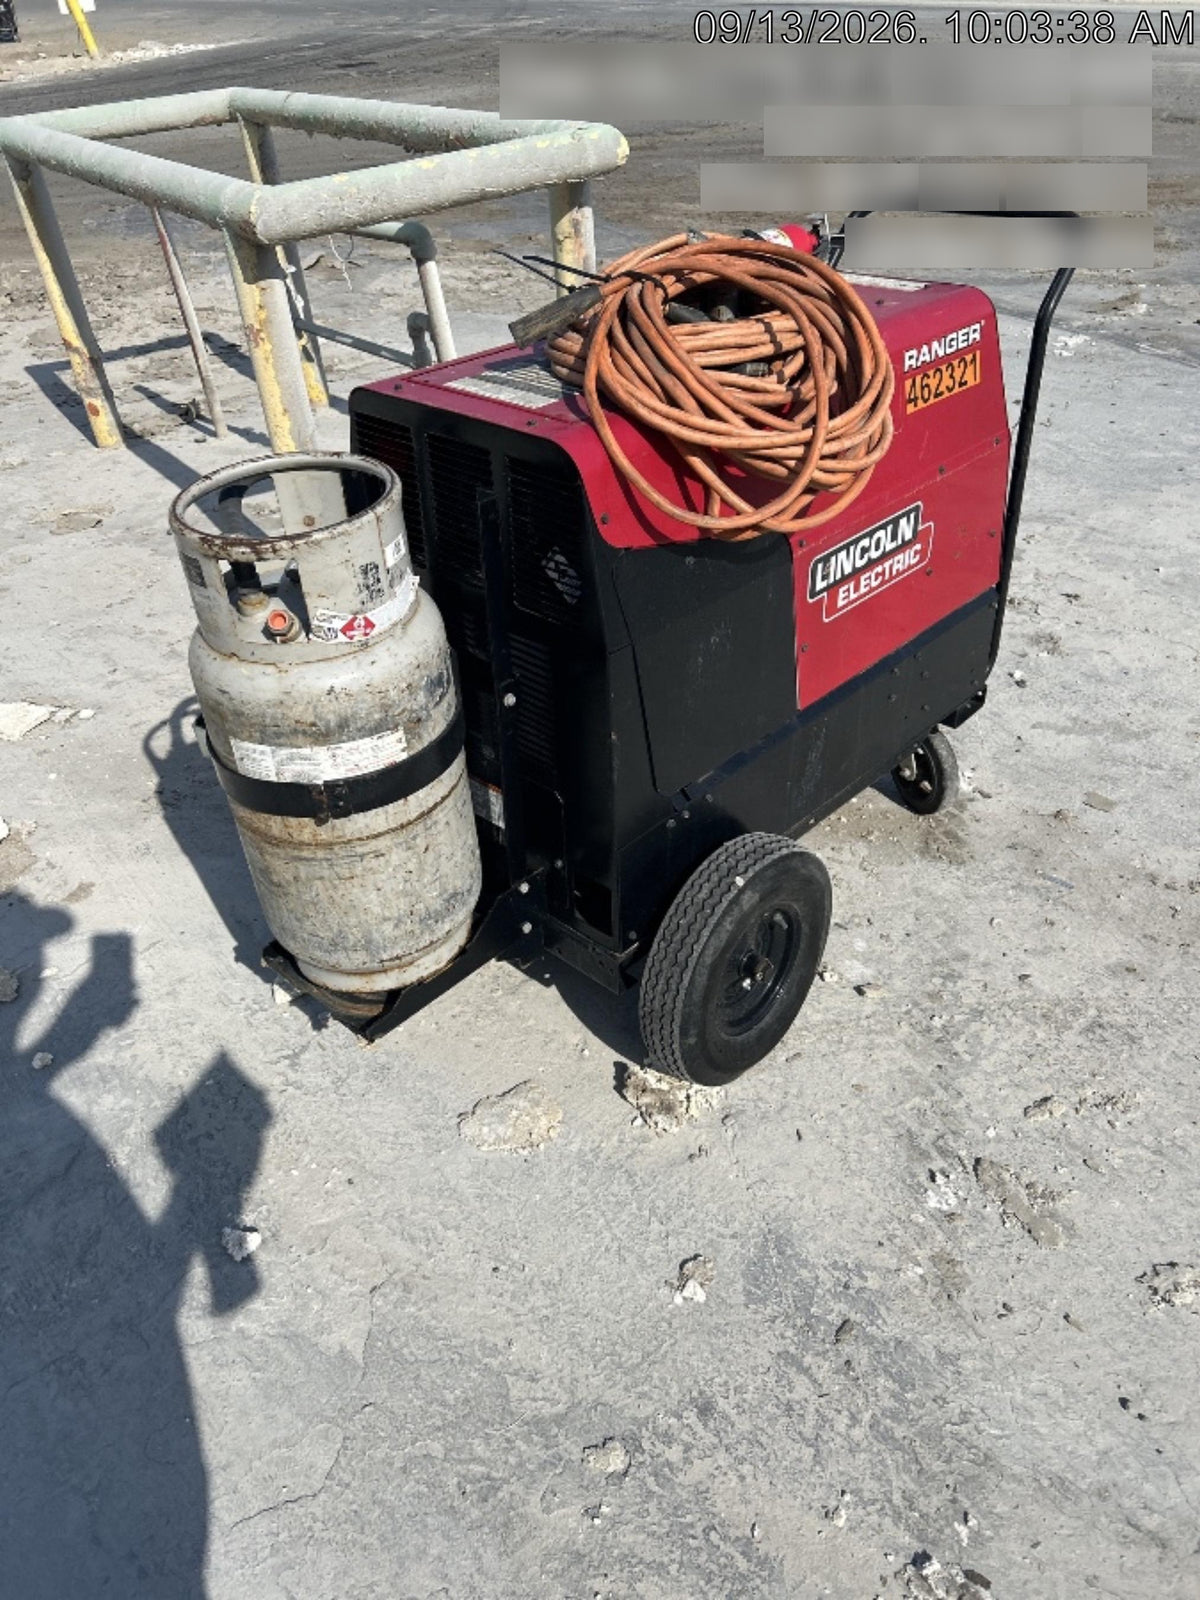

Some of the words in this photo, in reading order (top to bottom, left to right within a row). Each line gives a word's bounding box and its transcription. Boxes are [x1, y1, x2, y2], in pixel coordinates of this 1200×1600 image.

[903, 322, 981, 373] RANGER
[907, 352, 977, 408] 462321
[815, 511, 916, 592] LINCOLN
[836, 543, 922, 609] ELECTRIC
